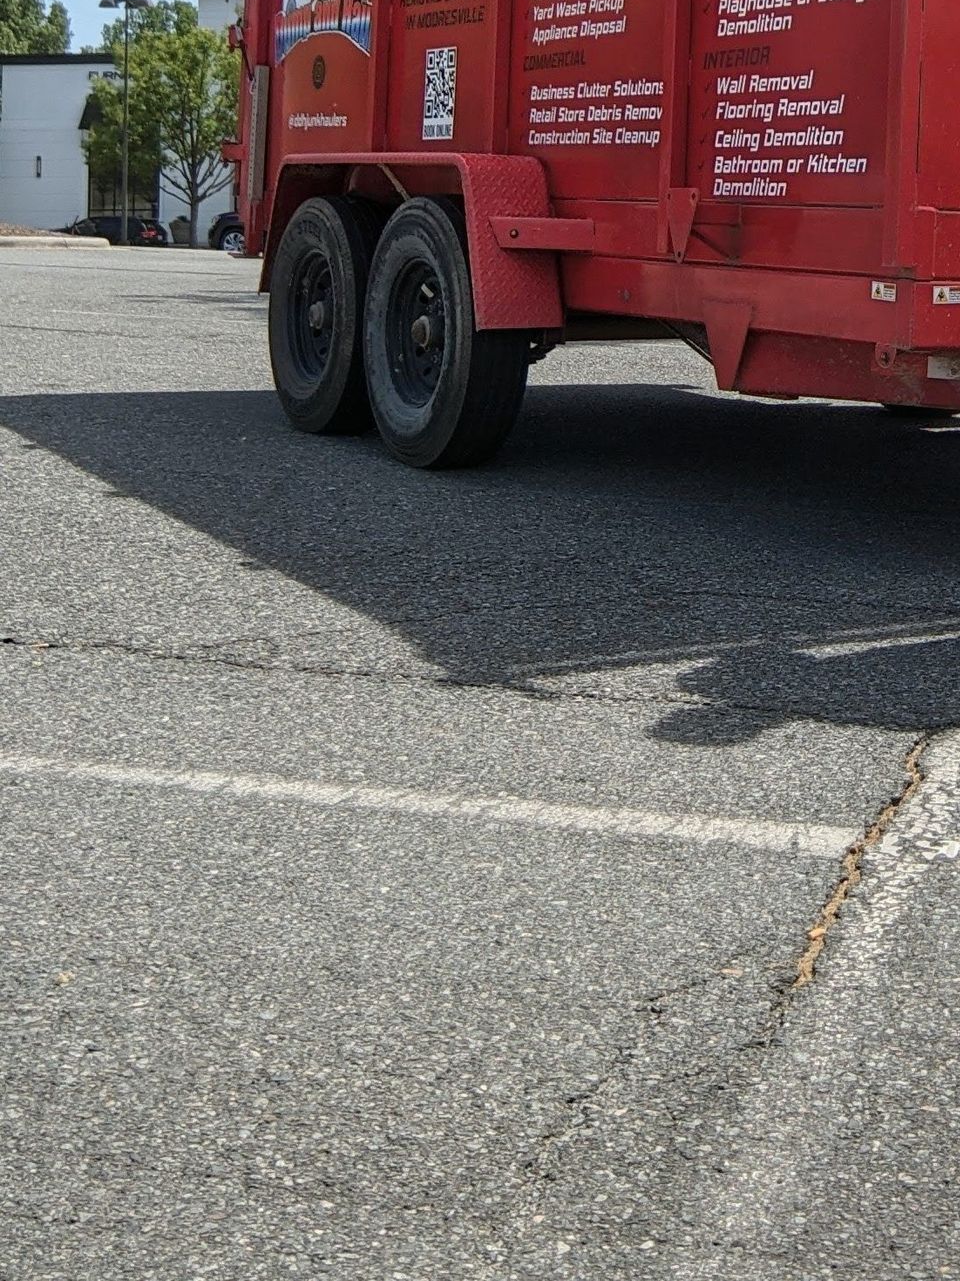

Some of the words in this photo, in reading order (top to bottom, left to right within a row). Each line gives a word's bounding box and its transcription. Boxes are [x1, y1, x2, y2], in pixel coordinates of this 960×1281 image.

[416, 5, 485, 29] MOORESVILLE
[533, 5, 553, 22] Yard
[555, 1, 586, 18] Waste
[532, 24, 578, 46] Appliance
[579, 15, 627, 39] Disposal
[717, 12, 793, 37] Demolition
[523, 49, 586, 71] COMMERCIAL
[703, 46, 771, 70] INTERIOR
[530, 84, 575, 101] Business
[577, 81, 611, 99] Clutter
[613, 78, 663, 96] Solutions
[716, 75, 746, 95] Wall
[749, 69, 814, 93] Removal
[529, 106, 556, 124] Retail
[558, 106, 585, 123] Store
[587, 104, 622, 121] Debris
[715, 99, 774, 122] Flooring
[777, 94, 845, 117] Removal
[528, 127, 590, 145] Construction
[592, 127, 612, 144] Site
[615, 126, 661, 148] Cleanup
[714, 128, 761, 152] Ceiling
[763, 125, 844, 147] Demolition
[713, 155, 783, 174] Bathroom
[786, 158, 804, 173] or
[806, 153, 867, 173] Kitchen
[713, 177, 787, 197] Demolition
